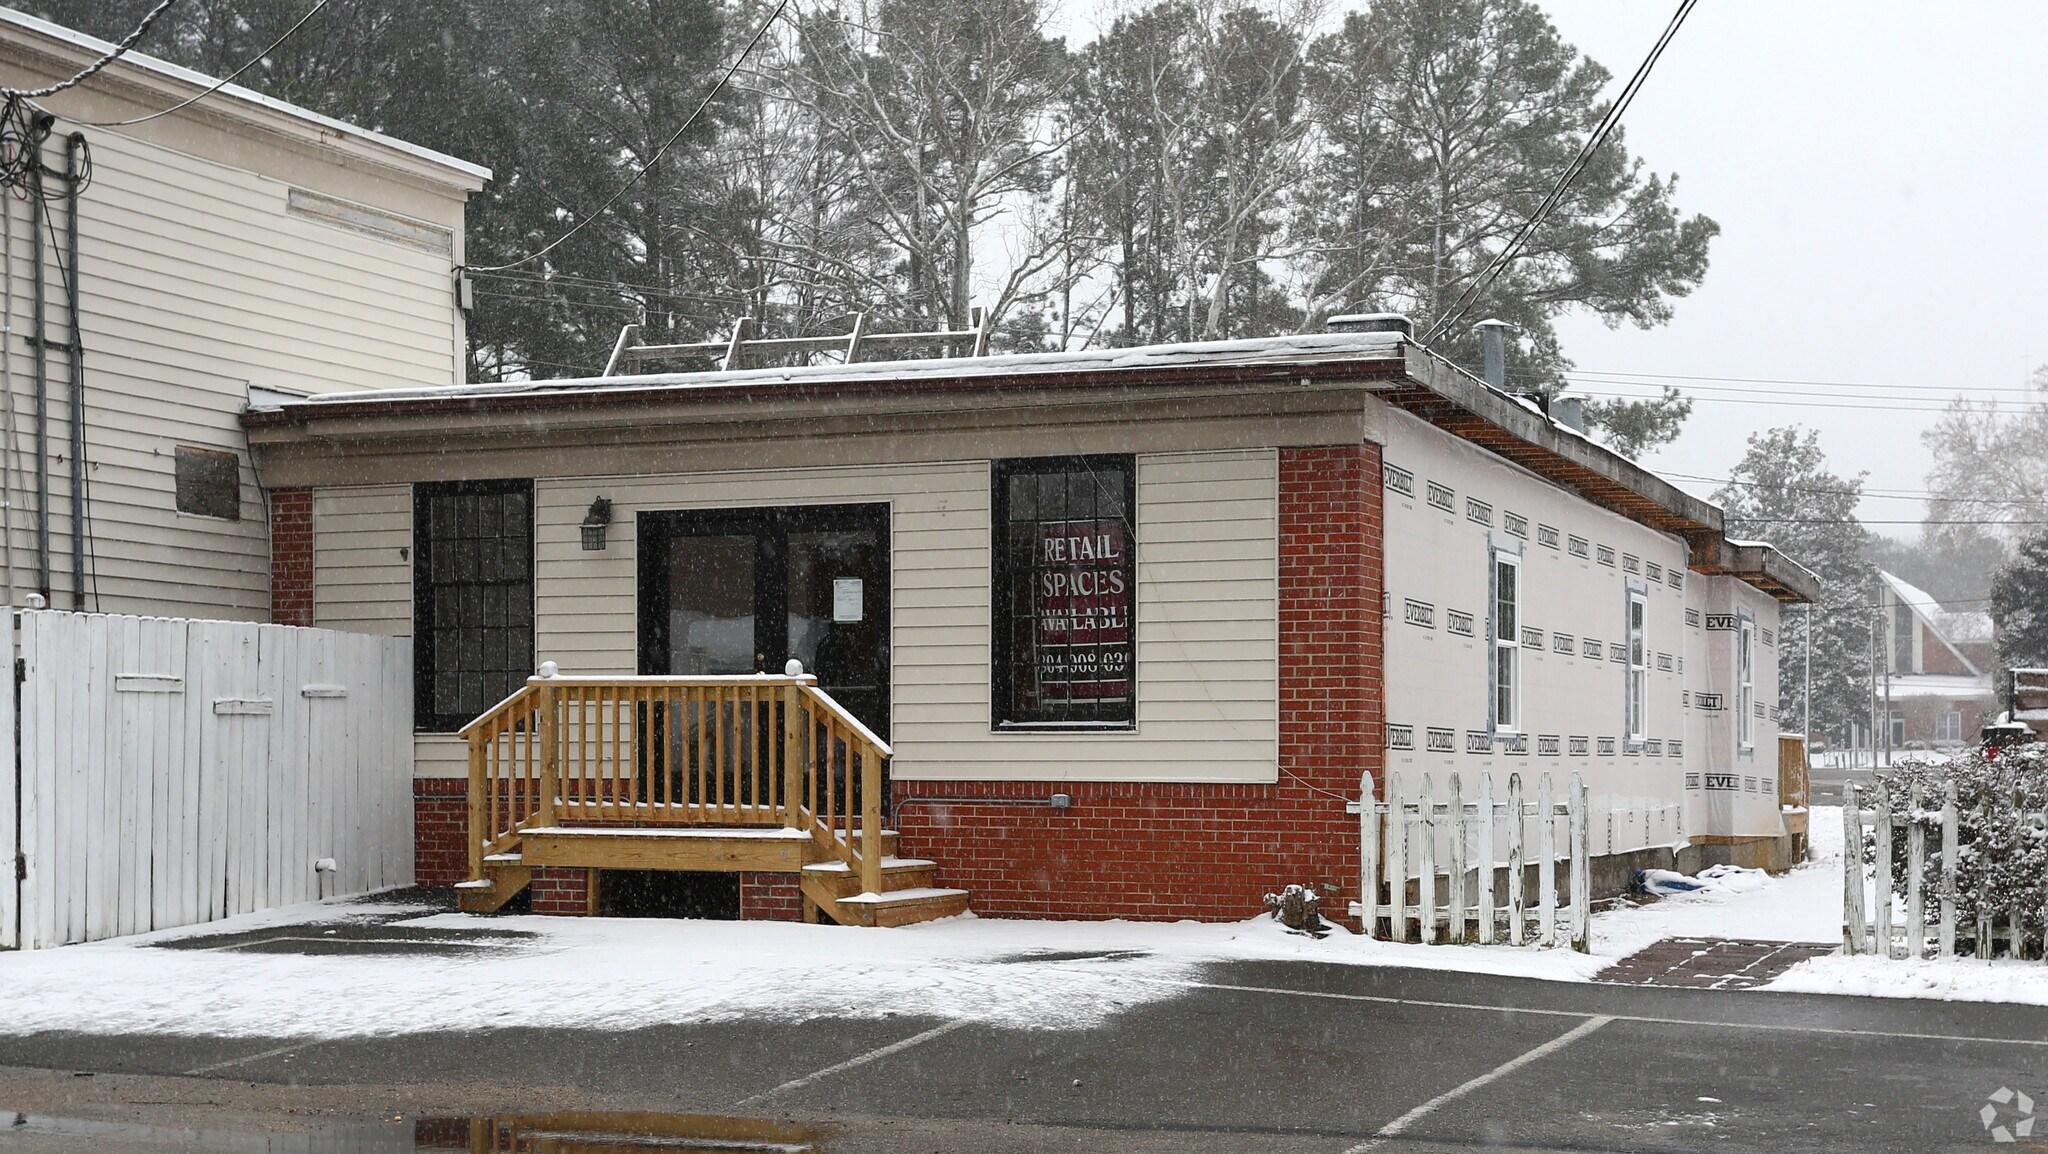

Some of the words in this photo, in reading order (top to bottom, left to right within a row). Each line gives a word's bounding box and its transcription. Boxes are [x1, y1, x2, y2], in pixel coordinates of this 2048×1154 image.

[1428, 485, 1454, 509] EVERBILT
[1468, 501, 1492, 523] EVERBILT
[1044, 535, 1119, 562] RETAIL
[1043, 570, 1124, 597] SPACES
[1406, 602, 1432, 624] EVERBILT
[1449, 613, 1472, 633] EVERBILT
[1428, 732, 1453, 749] EVERBILT
